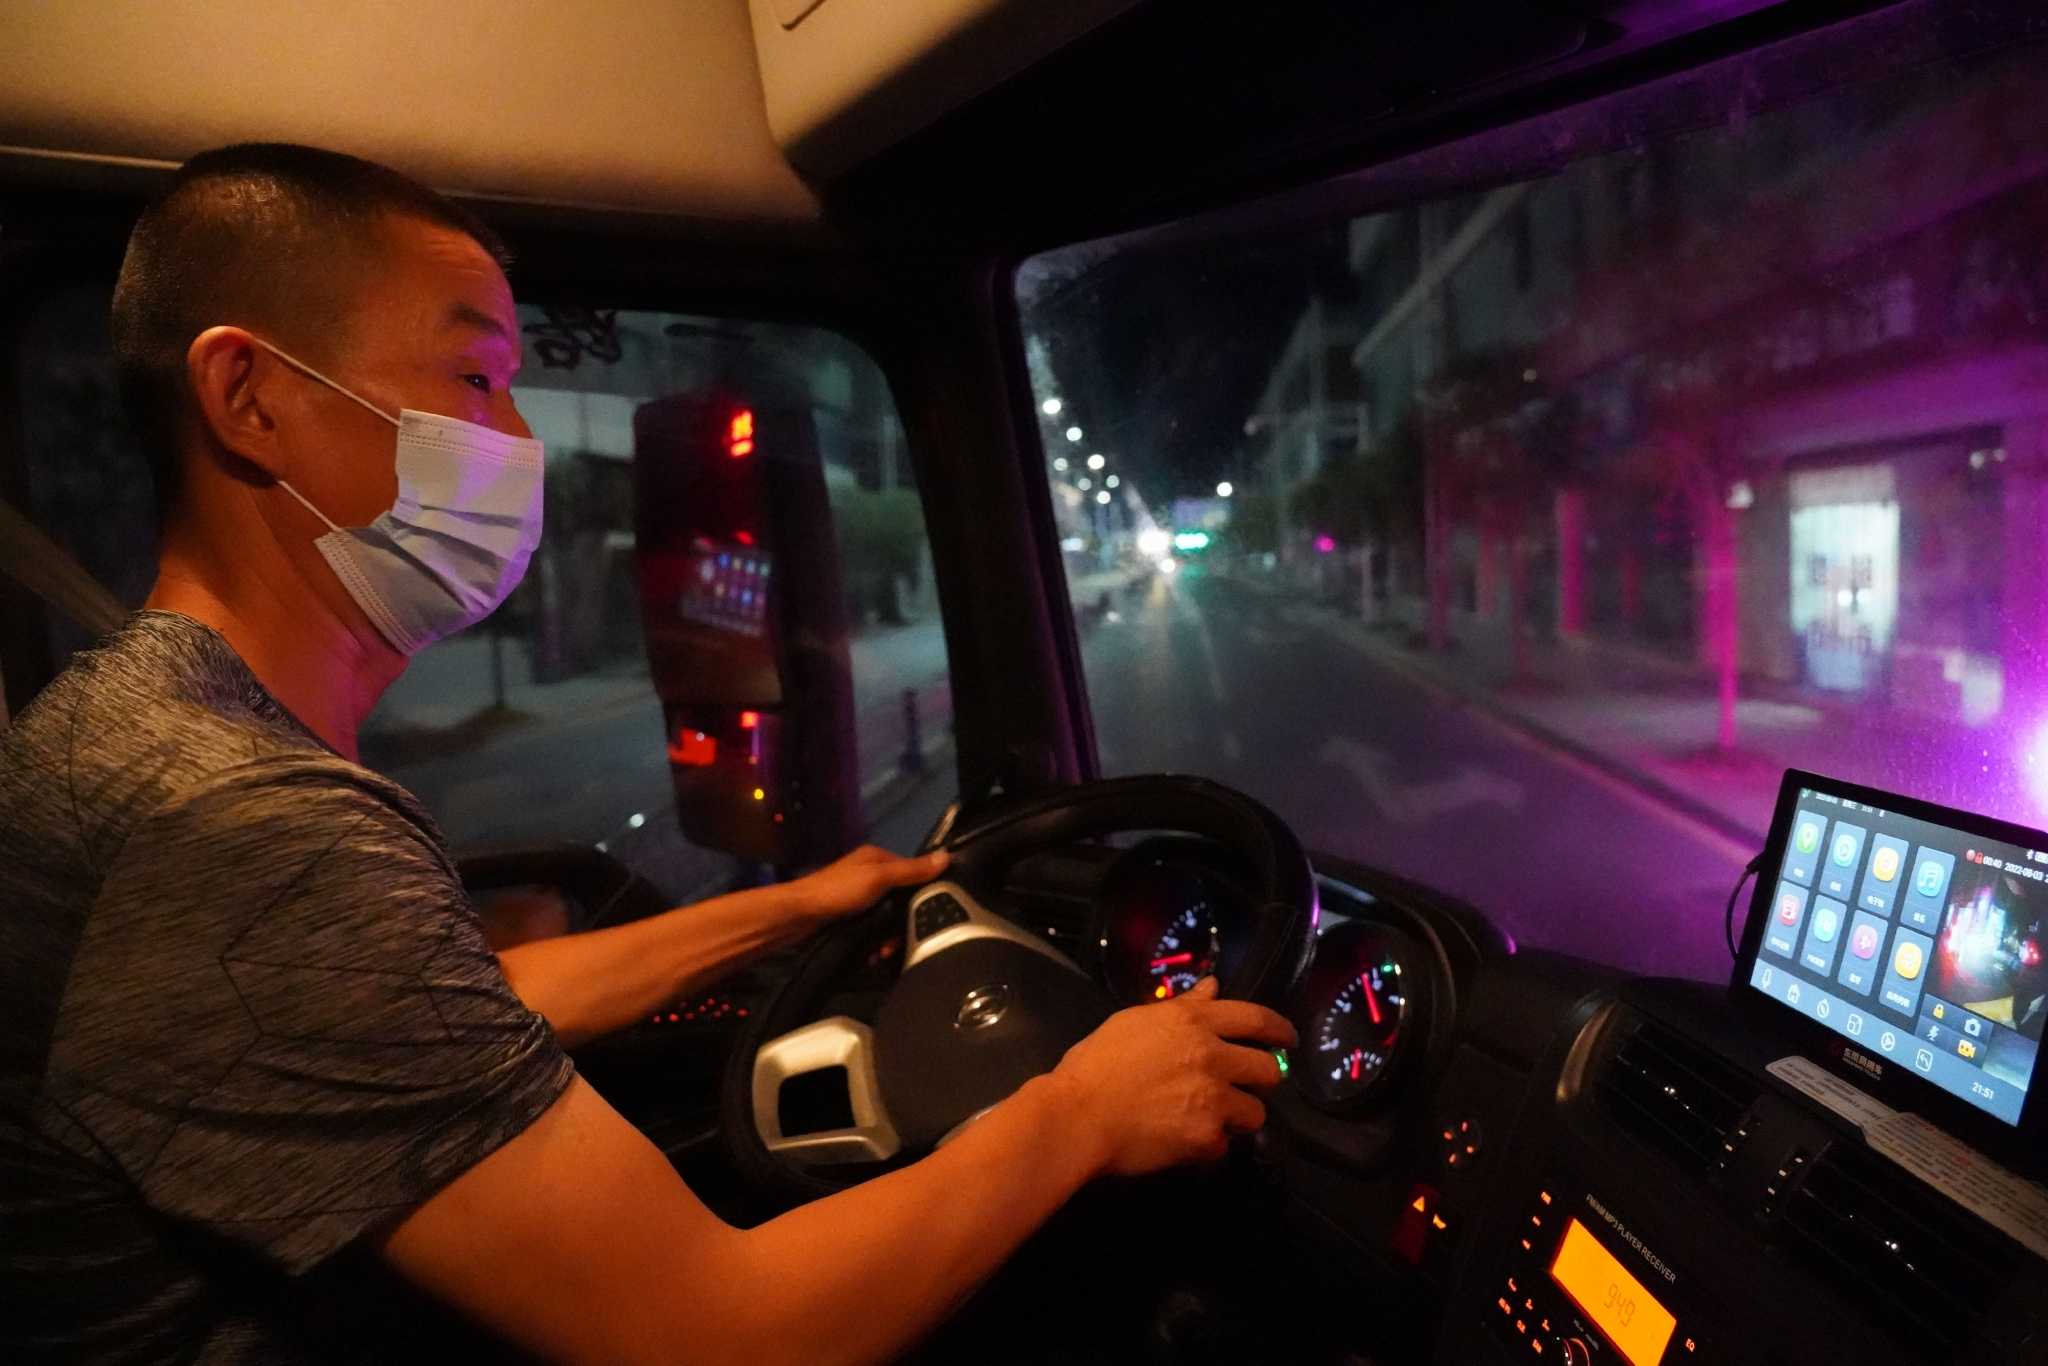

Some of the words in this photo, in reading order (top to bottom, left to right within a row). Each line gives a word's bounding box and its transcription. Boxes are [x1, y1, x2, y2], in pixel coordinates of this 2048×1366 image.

[1983, 855, 2003, 869] 00:40
[2004, 862, 2044, 881] 2022-08-03
[1972, 1082, 1994, 1100] 21:51
[1604, 1211, 1619, 1229] MP3
[1617, 1223, 1642, 1252] PLAYER
[1641, 1246, 1676, 1284] RECEIVER
[1685, 1338, 1695, 1352] EQ
